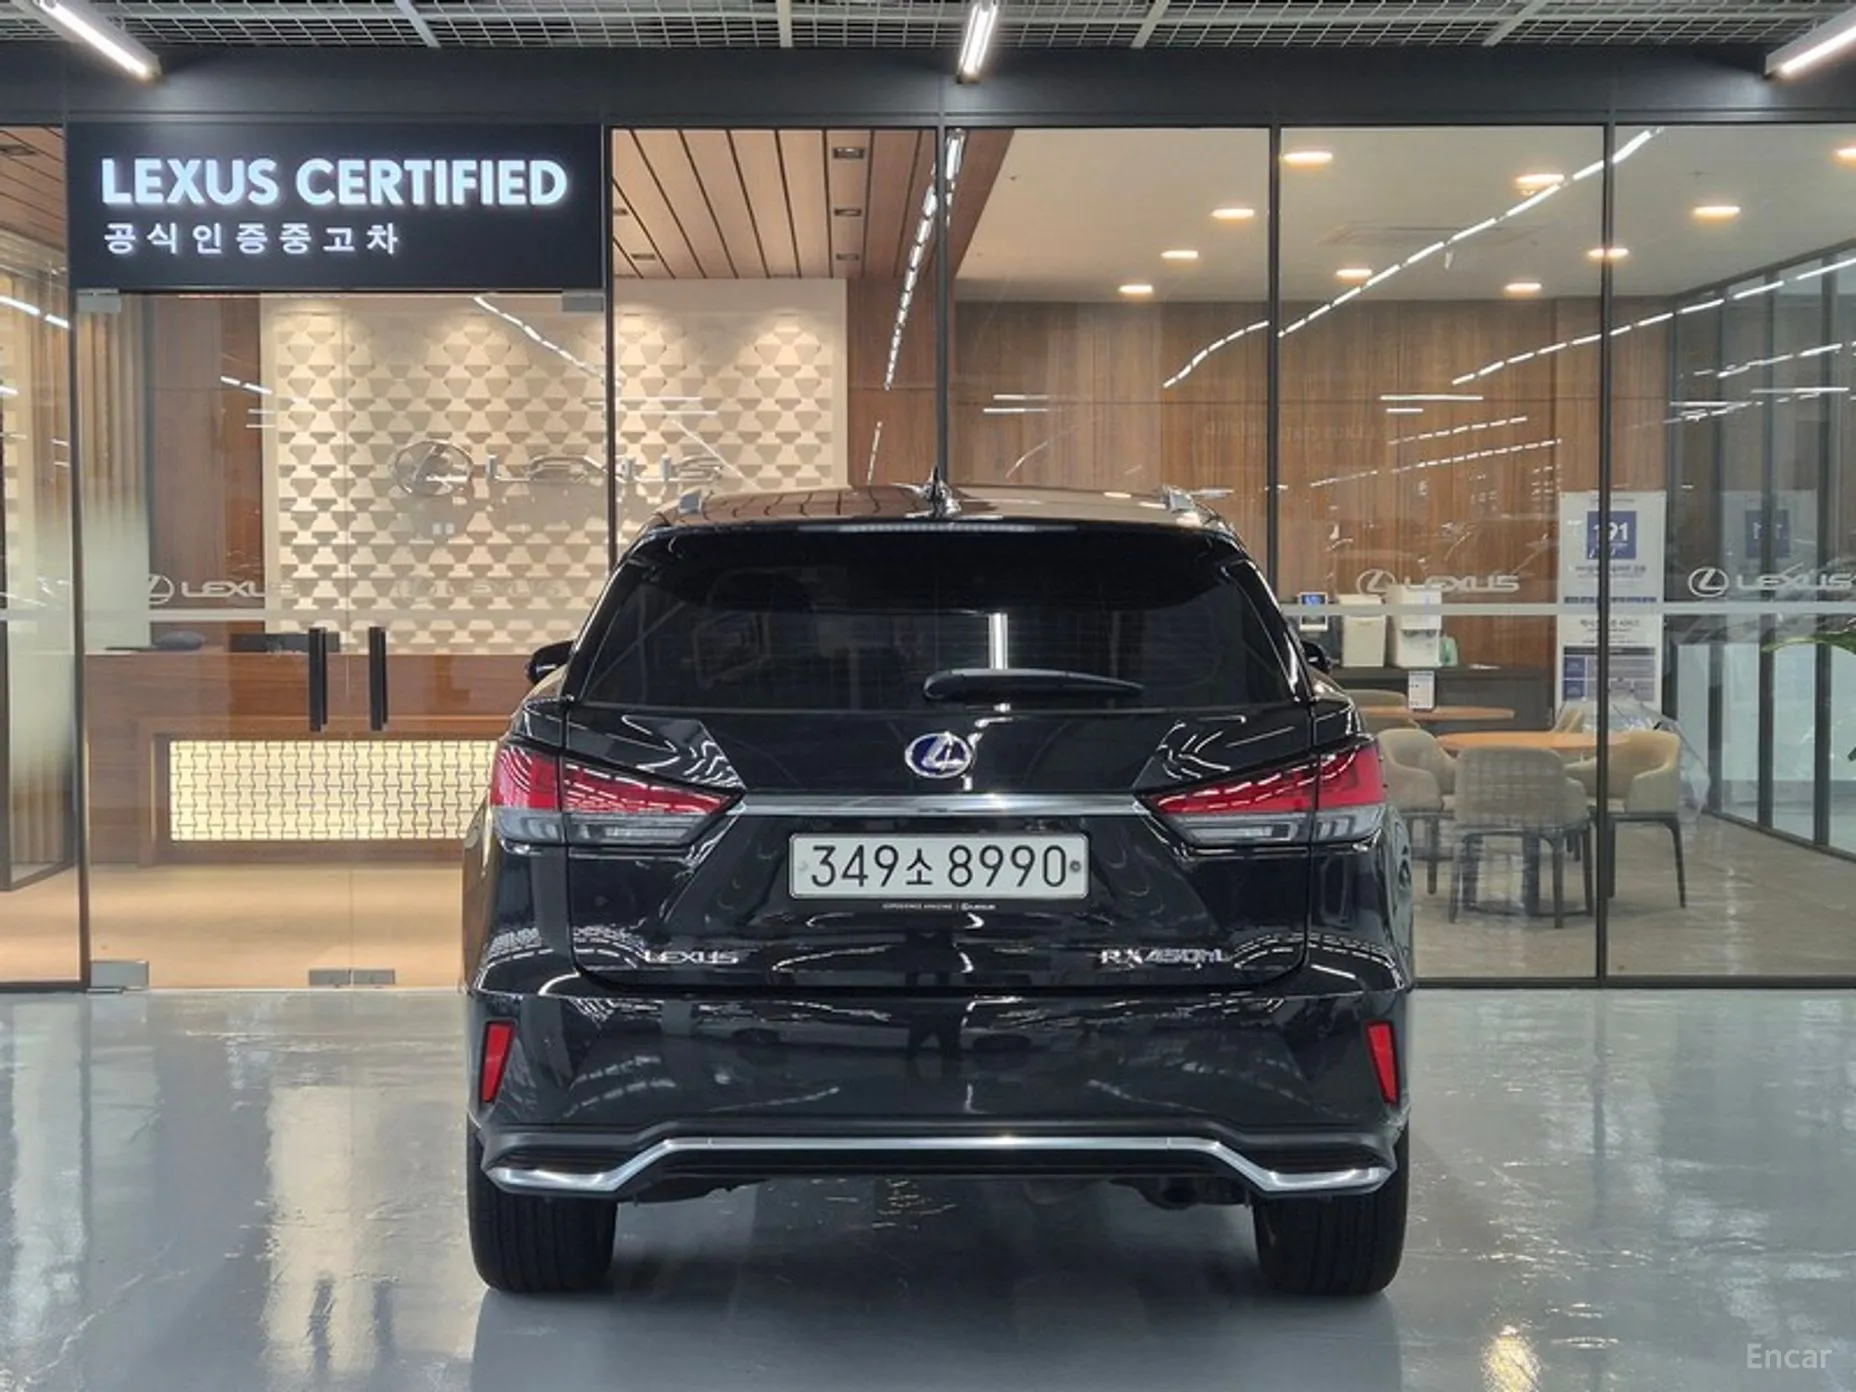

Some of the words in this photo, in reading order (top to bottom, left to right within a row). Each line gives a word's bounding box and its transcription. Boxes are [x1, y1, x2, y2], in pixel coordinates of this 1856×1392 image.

[101, 158, 279, 206] LEXUS
[296, 158, 568, 206] CERTIFIED
[1404, 574, 1520, 593] LEXUS
[1735, 573, 1852, 591] LEXUS
[811, 845, 933, 887] 349소
[948, 845, 1066, 887] 8990
[644, 950, 739, 964] LEXUS
